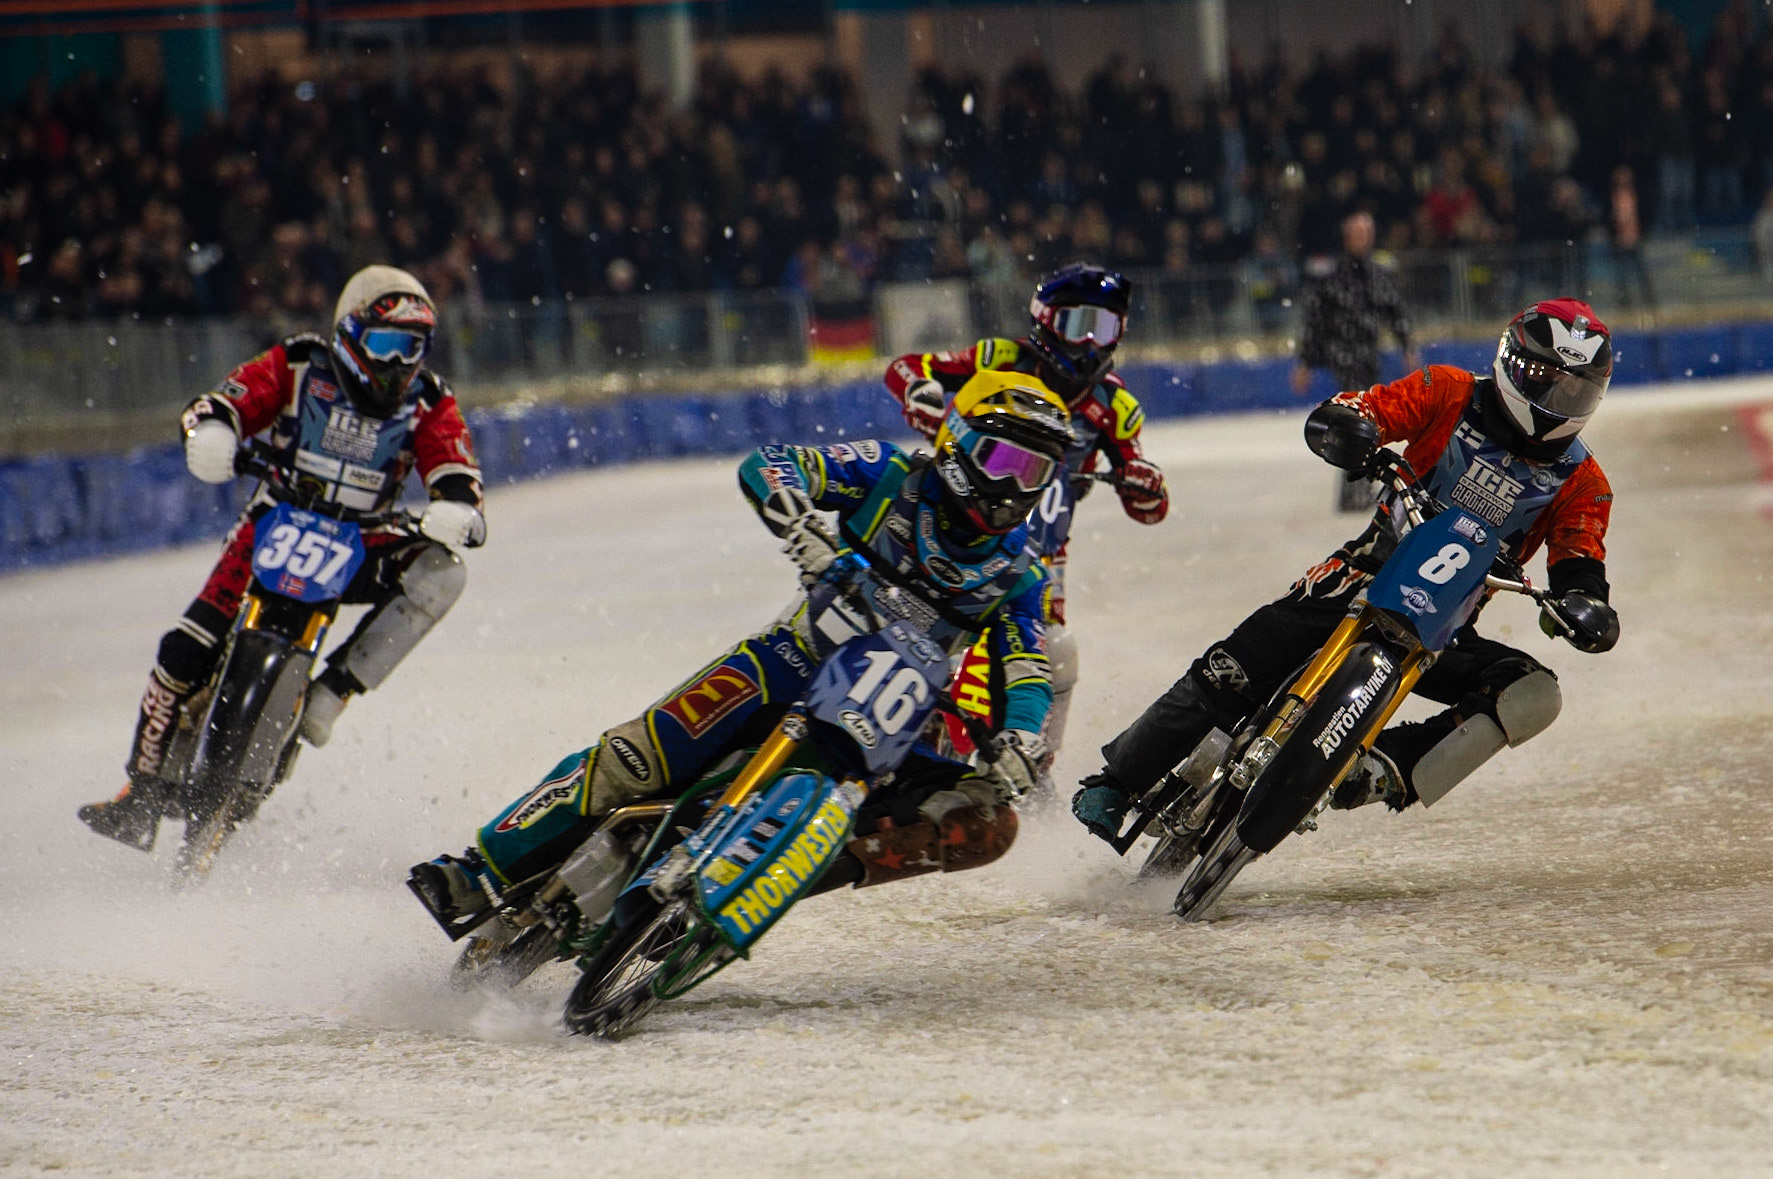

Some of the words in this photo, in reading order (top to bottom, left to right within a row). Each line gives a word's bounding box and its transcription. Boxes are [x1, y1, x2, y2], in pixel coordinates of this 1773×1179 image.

[1460, 477, 1513, 513] SPEEDWAY
[1464, 456, 1525, 506] ICE
[257, 524, 353, 586] 357
[1418, 543, 1470, 585] 8
[847, 650, 929, 736] 16
[1320, 667, 1388, 760] AUTOTARVIKE
[137, 686, 177, 776] RACING
[611, 738, 649, 780] ORTEMA
